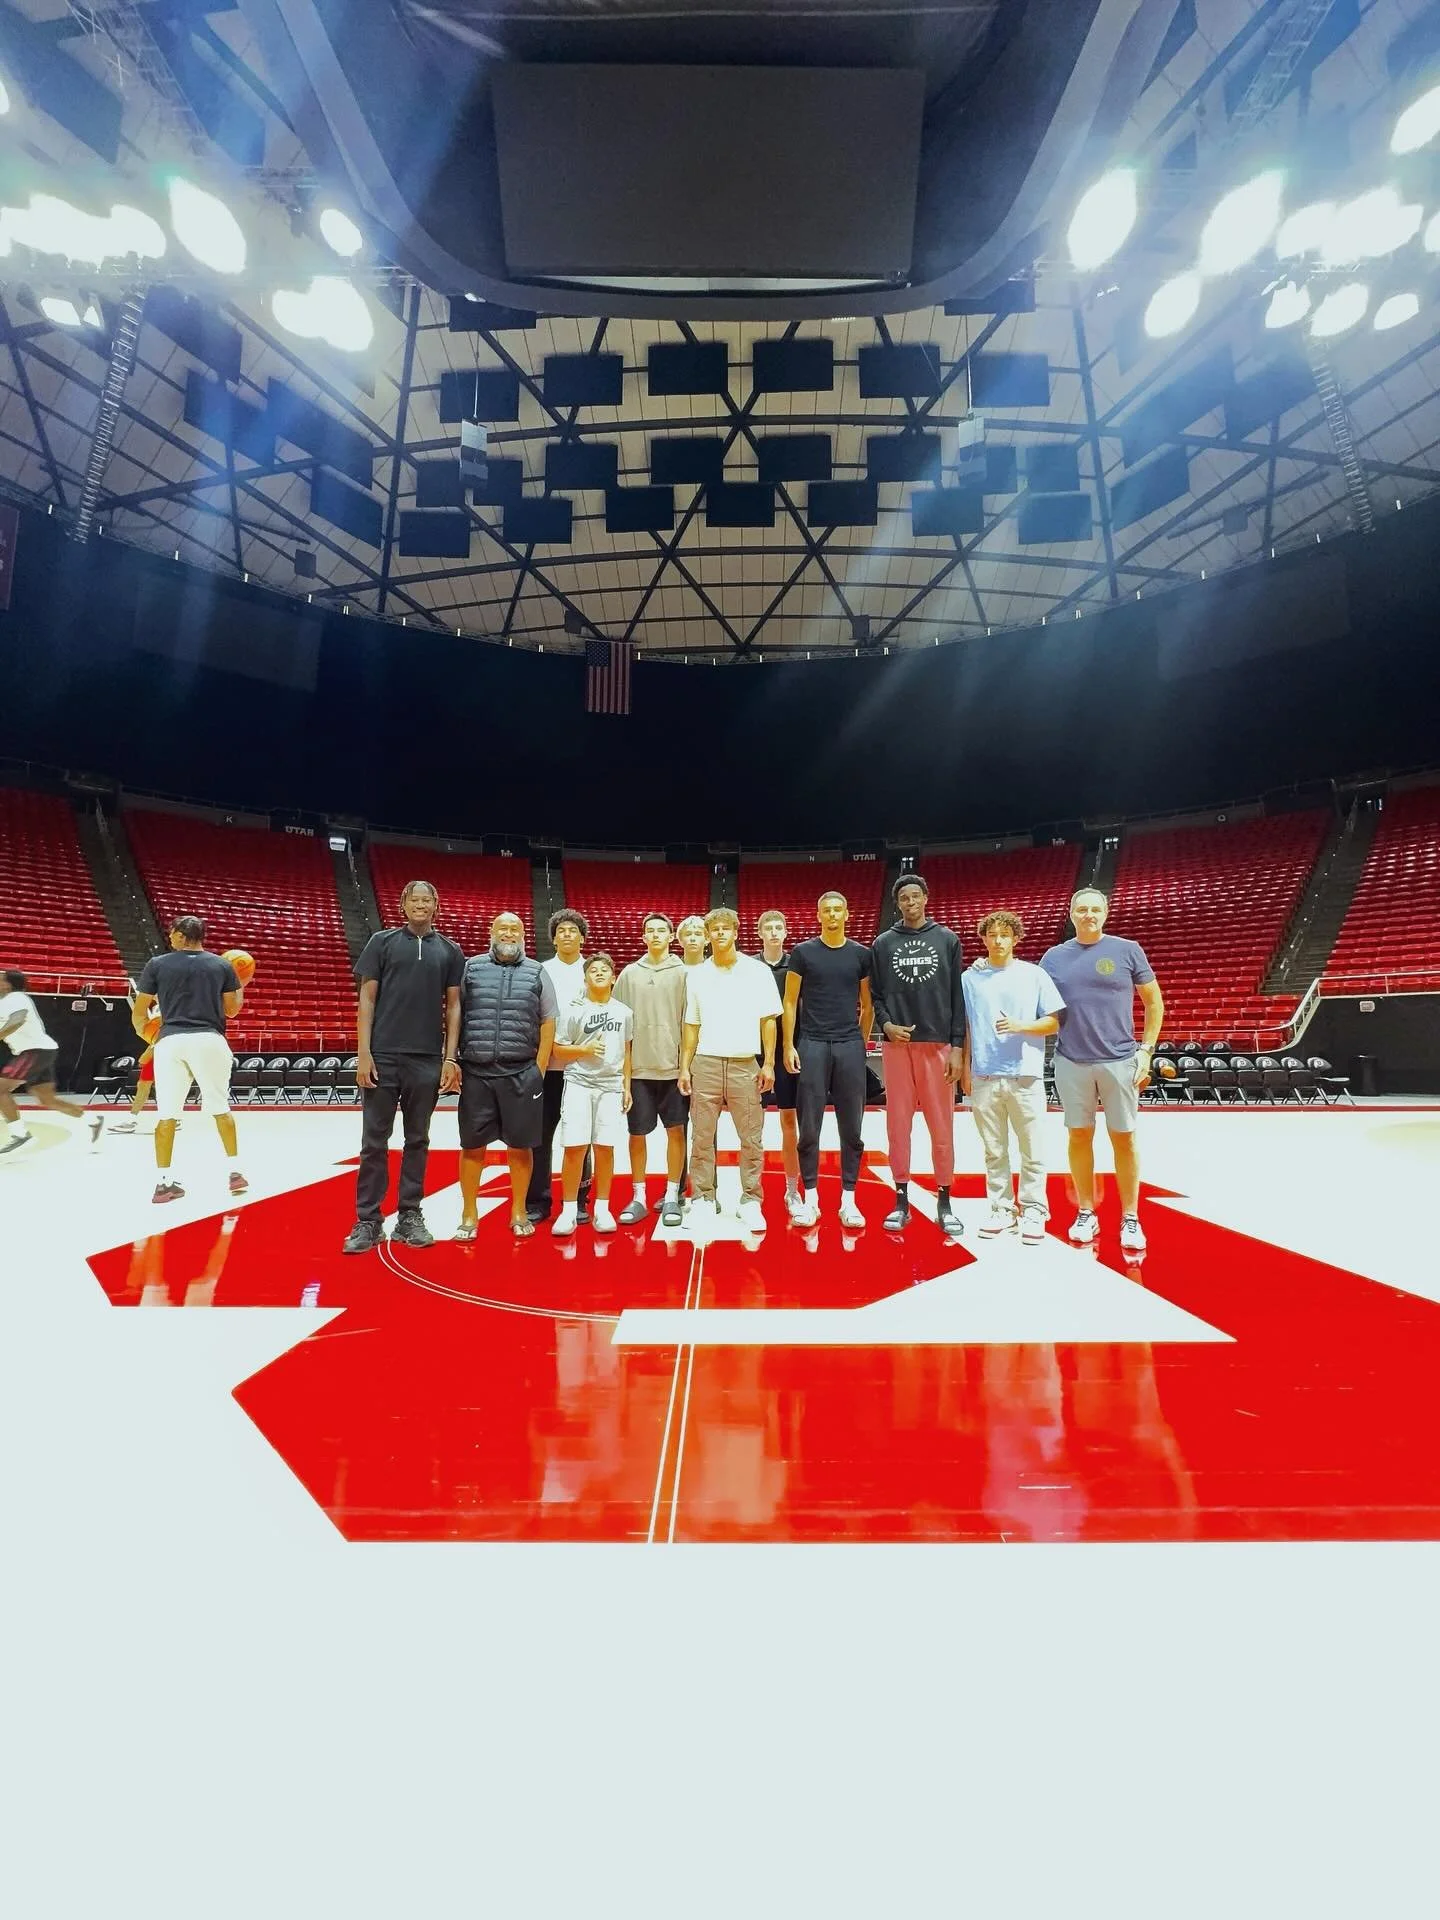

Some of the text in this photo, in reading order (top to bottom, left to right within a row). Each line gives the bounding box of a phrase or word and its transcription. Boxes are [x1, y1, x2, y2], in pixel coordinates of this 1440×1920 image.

[225, 816, 233, 824] K
[285, 825, 314, 837] UTAH
[852, 853, 876, 862] UTAH
[898, 956, 933, 967] KINGS
[588, 1011, 609, 1025] JUST
[614, 1021, 623, 1033] IT
